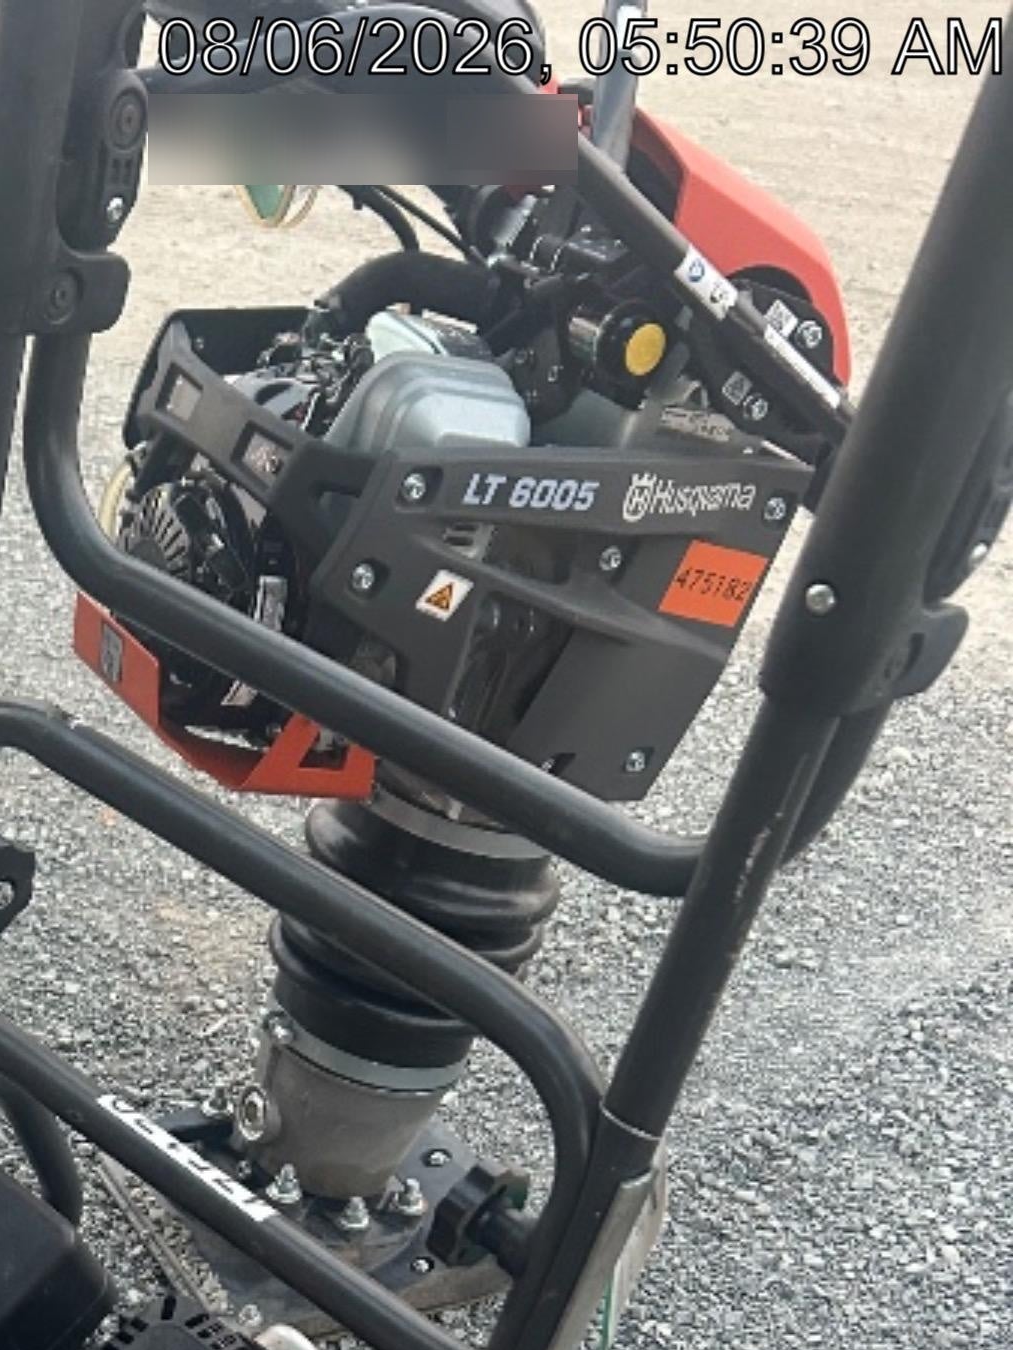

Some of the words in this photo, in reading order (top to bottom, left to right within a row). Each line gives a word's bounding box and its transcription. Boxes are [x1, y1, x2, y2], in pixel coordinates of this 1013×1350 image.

[462, 472, 507, 505] LT
[508, 476, 600, 511] 6005
[651, 477, 757, 516] Husqvarna
[675, 566, 754, 602] 475182
